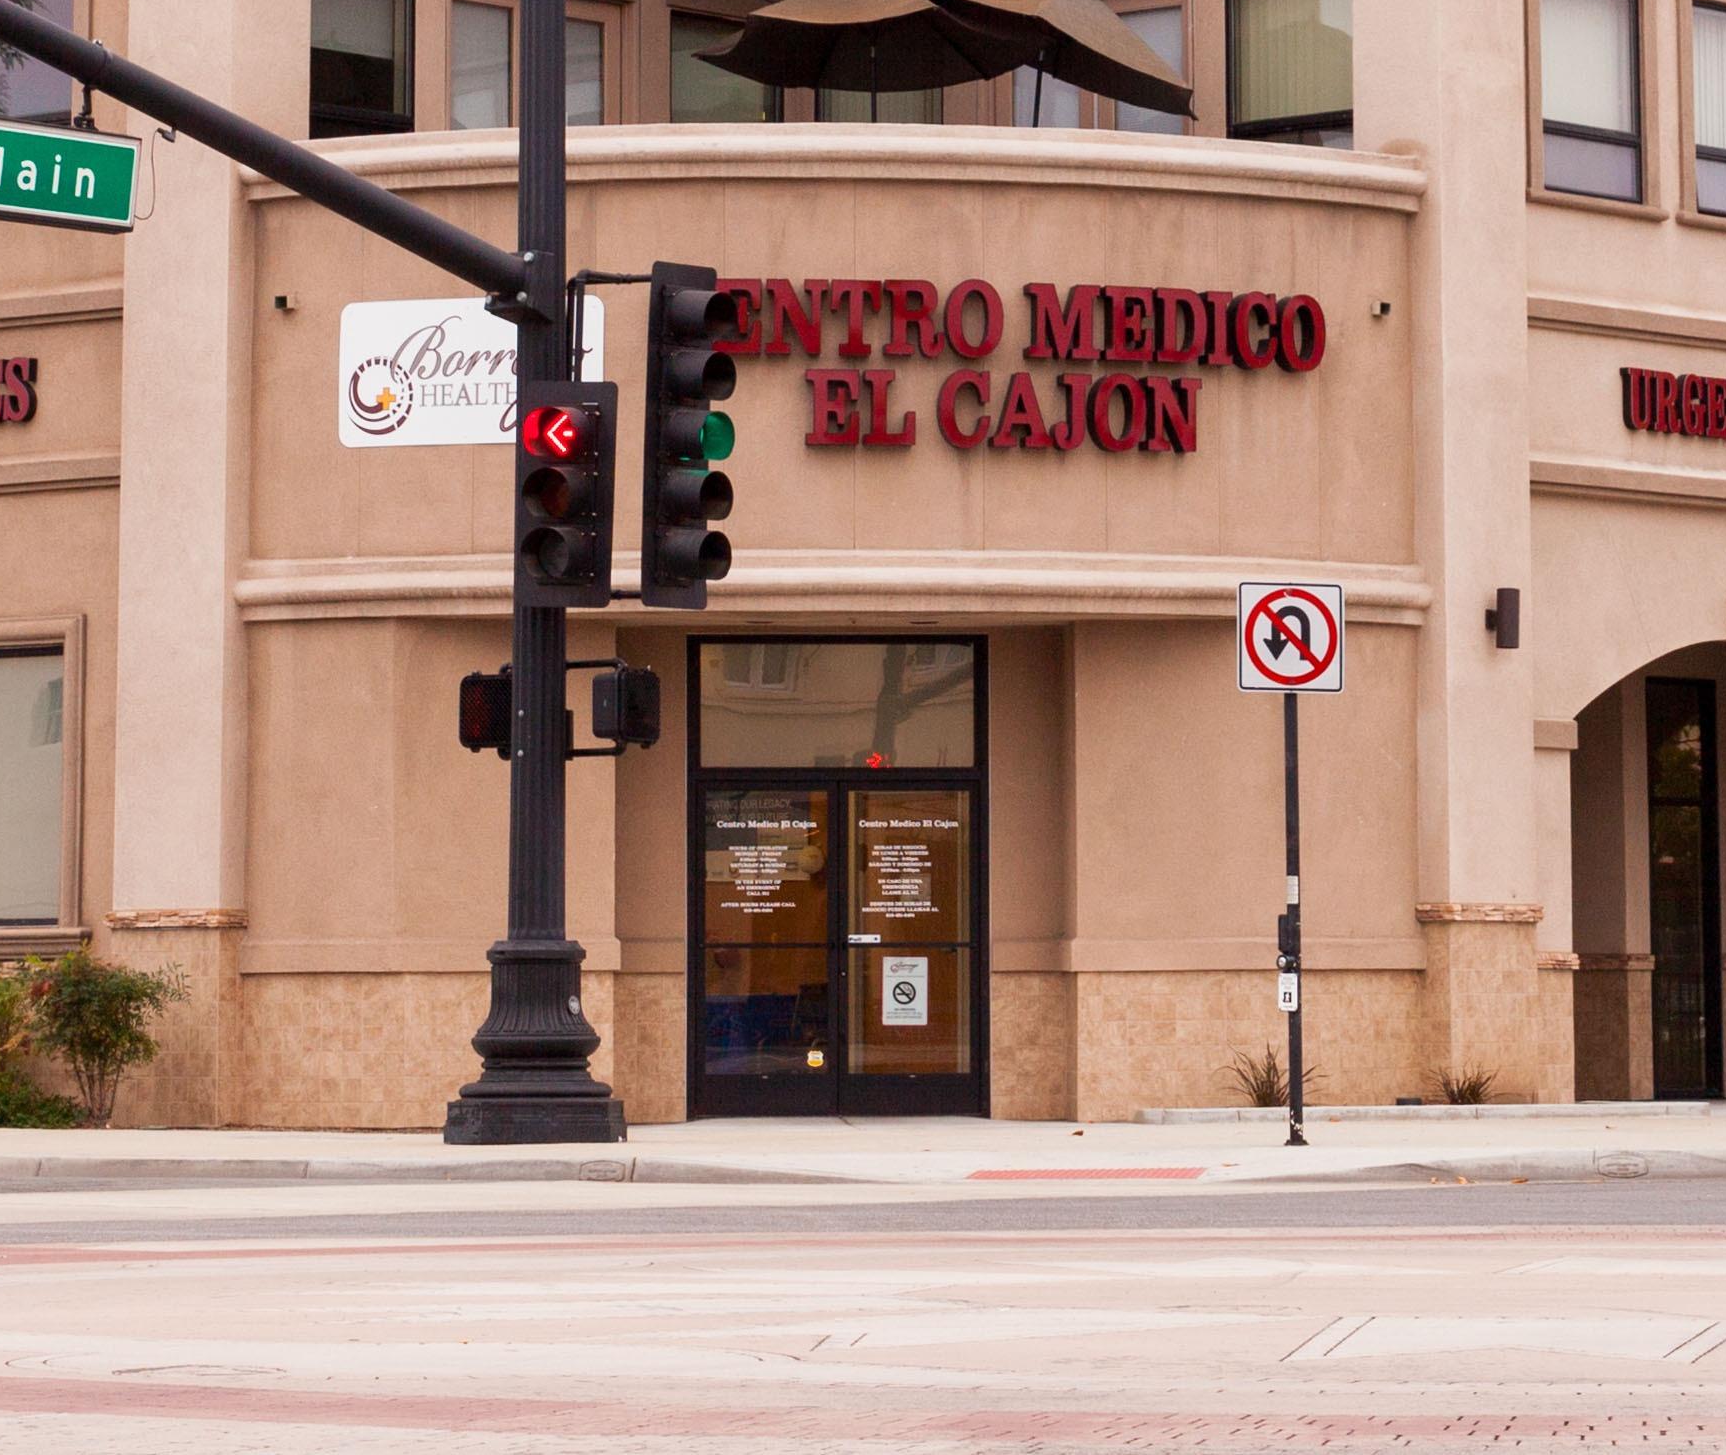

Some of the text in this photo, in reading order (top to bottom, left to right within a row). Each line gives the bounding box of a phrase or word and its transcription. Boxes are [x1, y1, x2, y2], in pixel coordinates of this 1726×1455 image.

[711, 277, 1326, 373] ENTRO MEDICO
[805, 369, 1202, 453] EL CAJON
[716, 820, 747, 829] Centro
[747, 819, 779, 829] Medico
[858, 819, 888, 828] Centro
[889, 819, 921, 828] Medico
[922, 819, 933, 828] El
